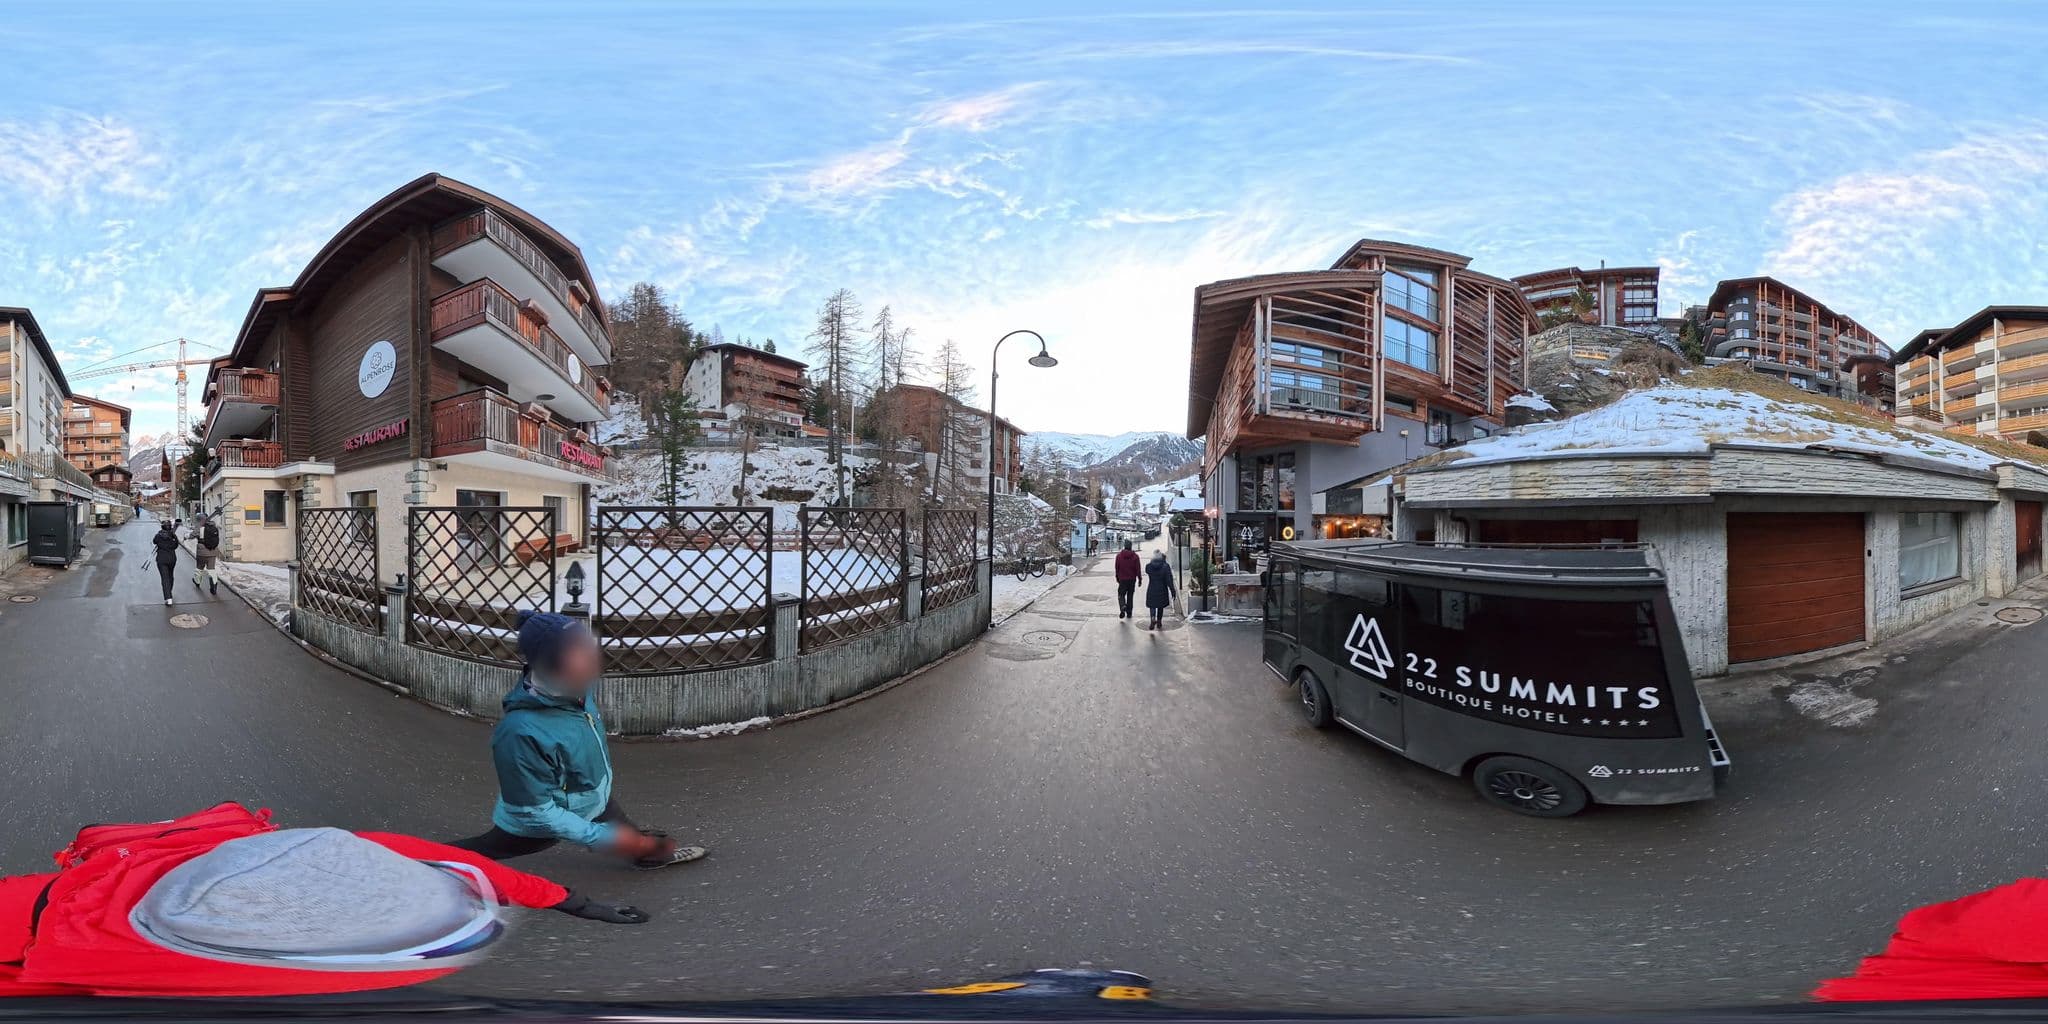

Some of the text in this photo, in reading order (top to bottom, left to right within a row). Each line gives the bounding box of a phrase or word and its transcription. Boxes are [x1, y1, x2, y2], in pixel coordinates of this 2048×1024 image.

[361, 361, 394, 384] ALPENROSE
[344, 419, 407, 450] RESTAURANT
[561, 441, 603, 469] RESTAURANT
[1406, 652, 1660, 709] 22 SUMMITS
[1406, 678, 1568, 724] BOUTIQUE HOTEL
[1638, 766, 1700, 774] SUMMITS
